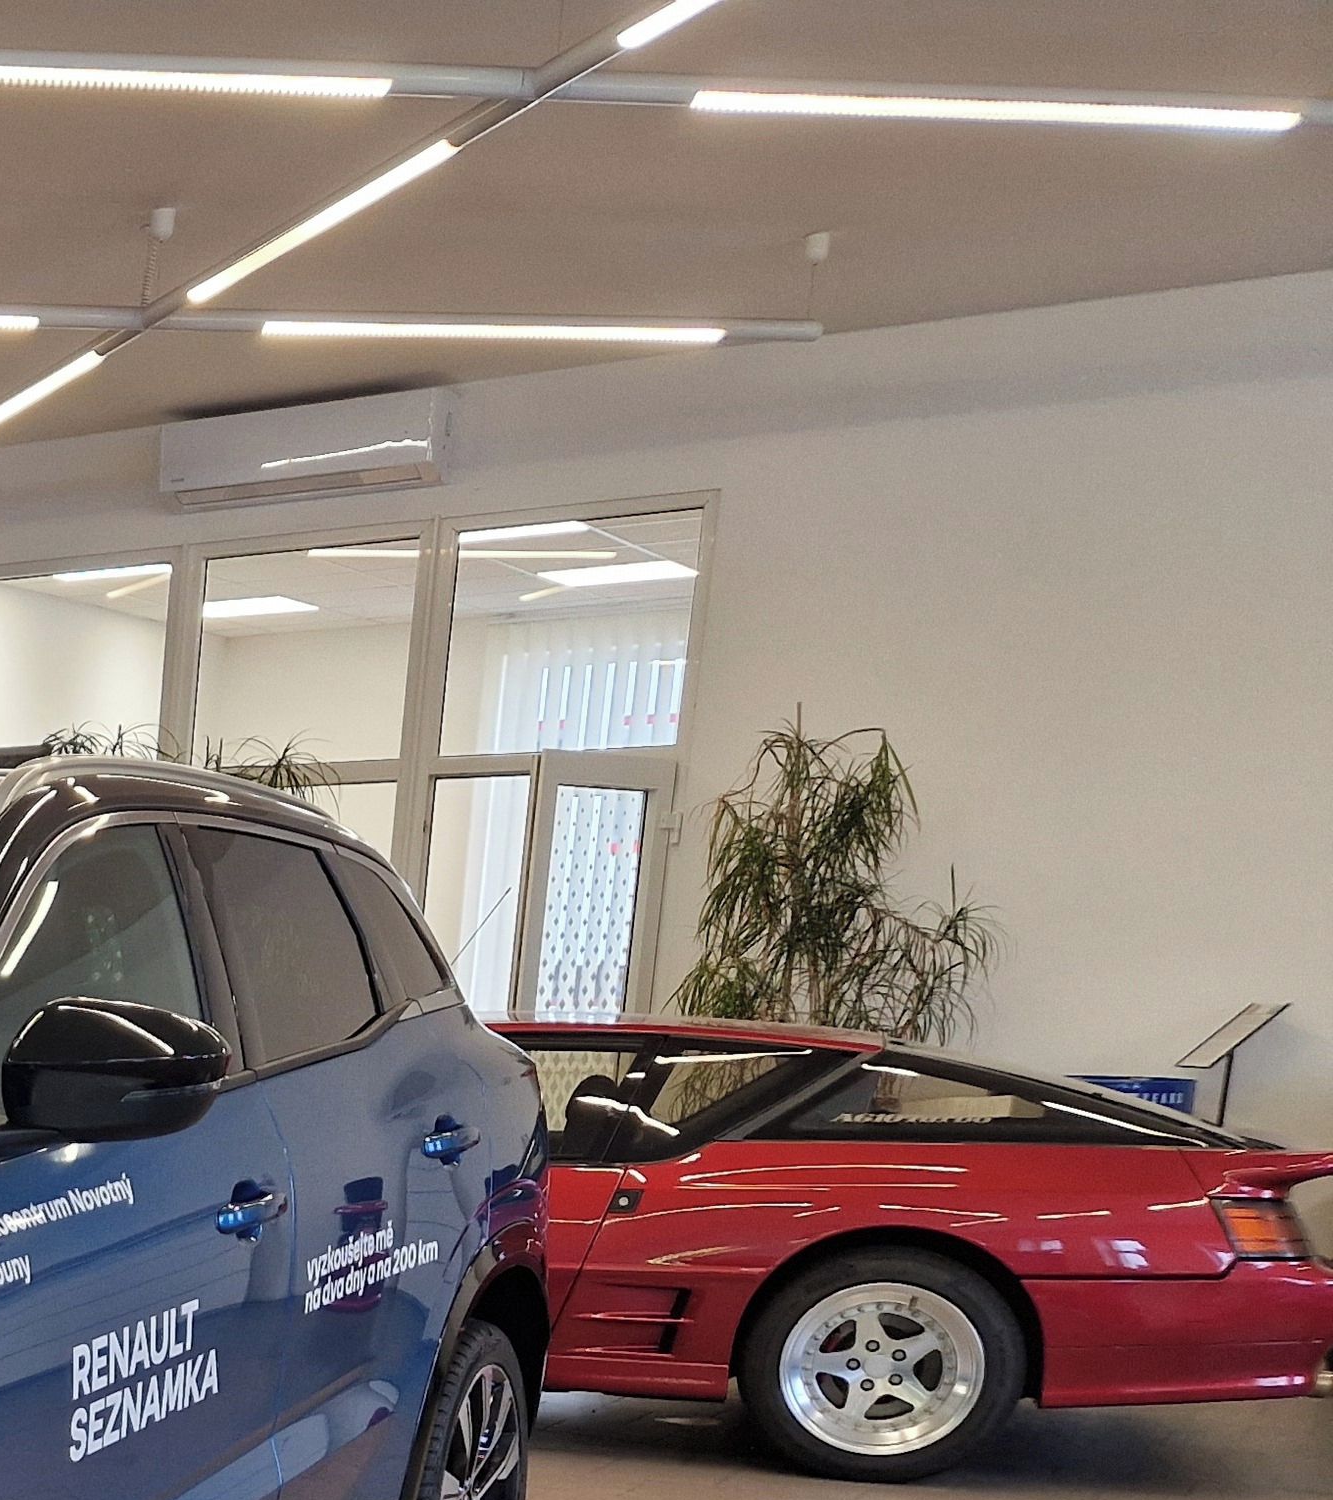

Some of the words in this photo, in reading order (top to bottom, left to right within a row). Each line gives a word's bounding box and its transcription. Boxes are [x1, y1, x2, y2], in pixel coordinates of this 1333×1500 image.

[67, 1172, 134, 1214] Novotný
[304, 1285, 322, 1315] na
[322, 1276, 346, 1306] dva
[345, 1265, 368, 1297] dny
[367, 1266, 376, 1285] a
[376, 1256, 393, 1283] na
[392, 1242, 416, 1276] 200
[418, 1239, 439, 1267] km
[307, 1231, 375, 1286] vyzkoušejte
[376, 1220, 394, 1251] mě
[72, 1298, 200, 1401] RENAULT
[69, 1348, 219, 1463] SEZNAMKA
